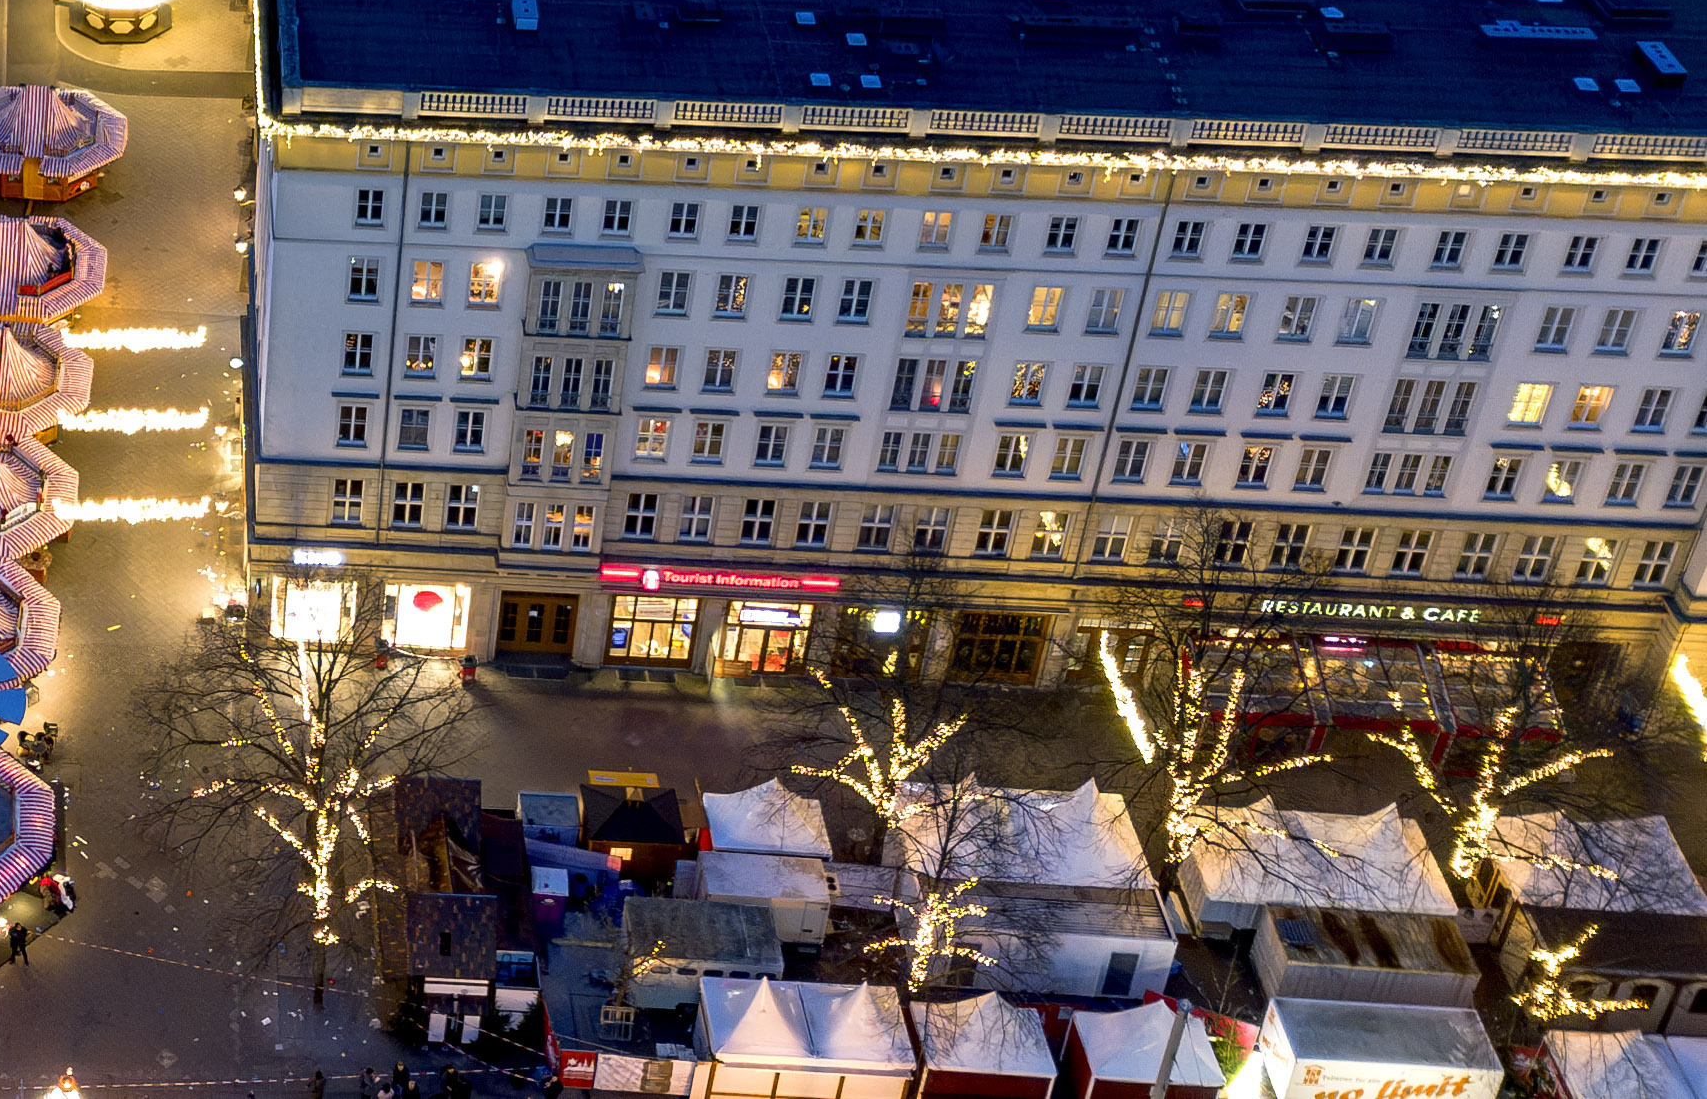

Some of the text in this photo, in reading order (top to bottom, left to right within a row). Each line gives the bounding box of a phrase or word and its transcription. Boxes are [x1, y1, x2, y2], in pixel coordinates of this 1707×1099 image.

[663, 570, 800, 588] Tourist Information
[1260, 600, 1396, 619] RESTAURANT
[1400, 606, 1415, 619] &
